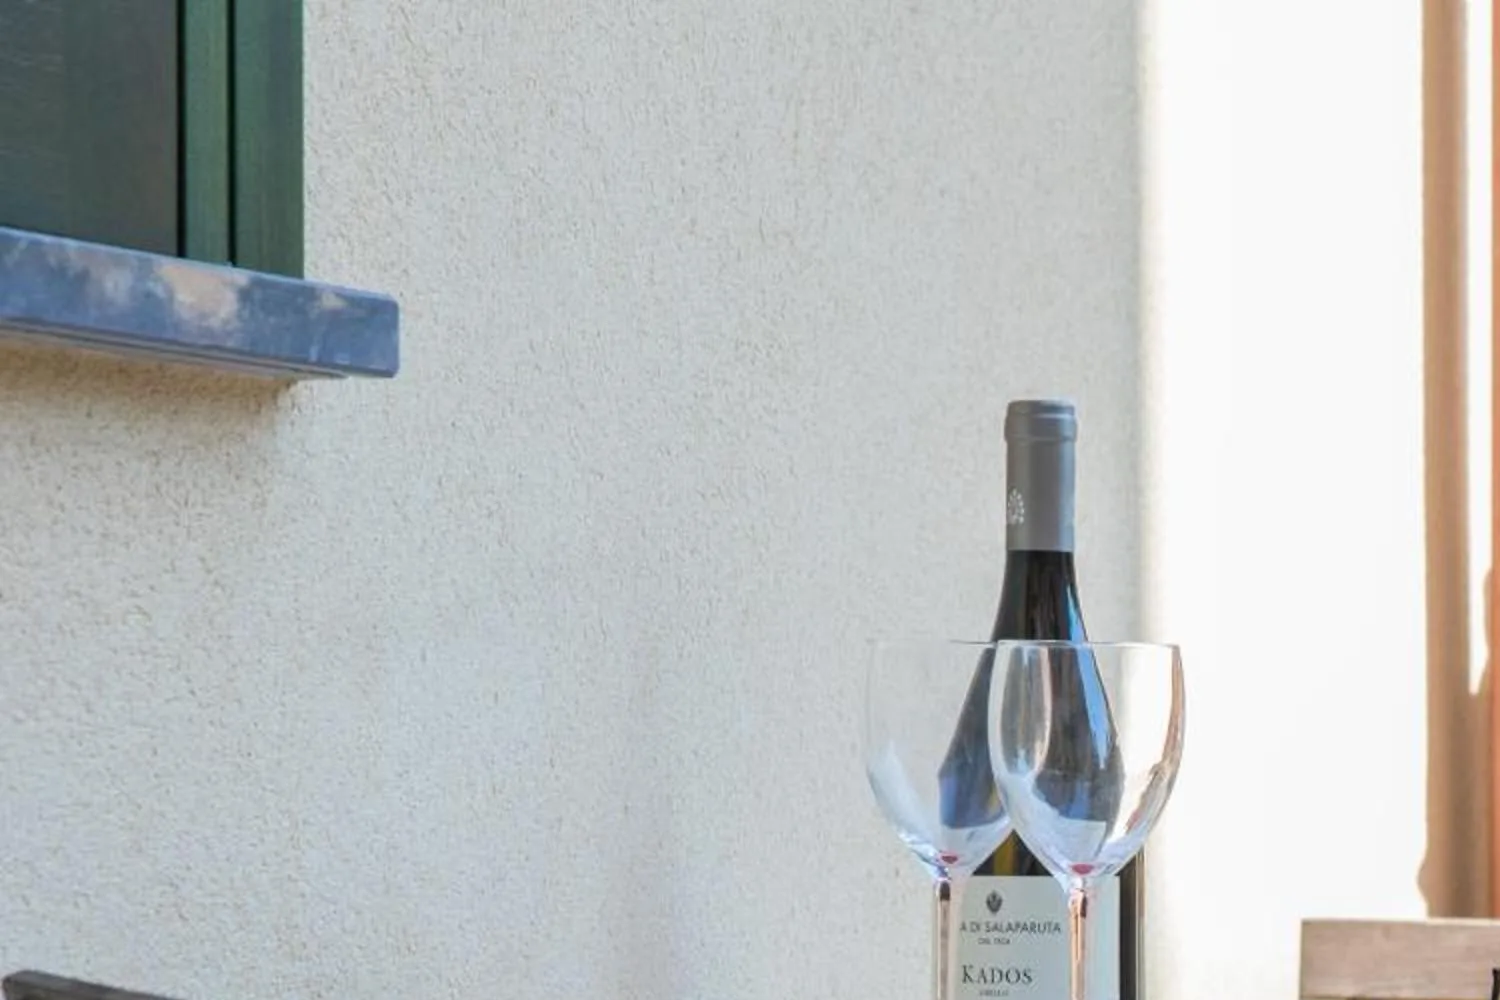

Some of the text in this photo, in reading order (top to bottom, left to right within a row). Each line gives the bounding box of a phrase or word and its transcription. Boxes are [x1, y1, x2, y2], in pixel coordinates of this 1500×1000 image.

[969, 920, 980, 932] DI
[985, 920, 1061, 934] SALAPARUTA
[961, 964, 1033, 986] KADOS
